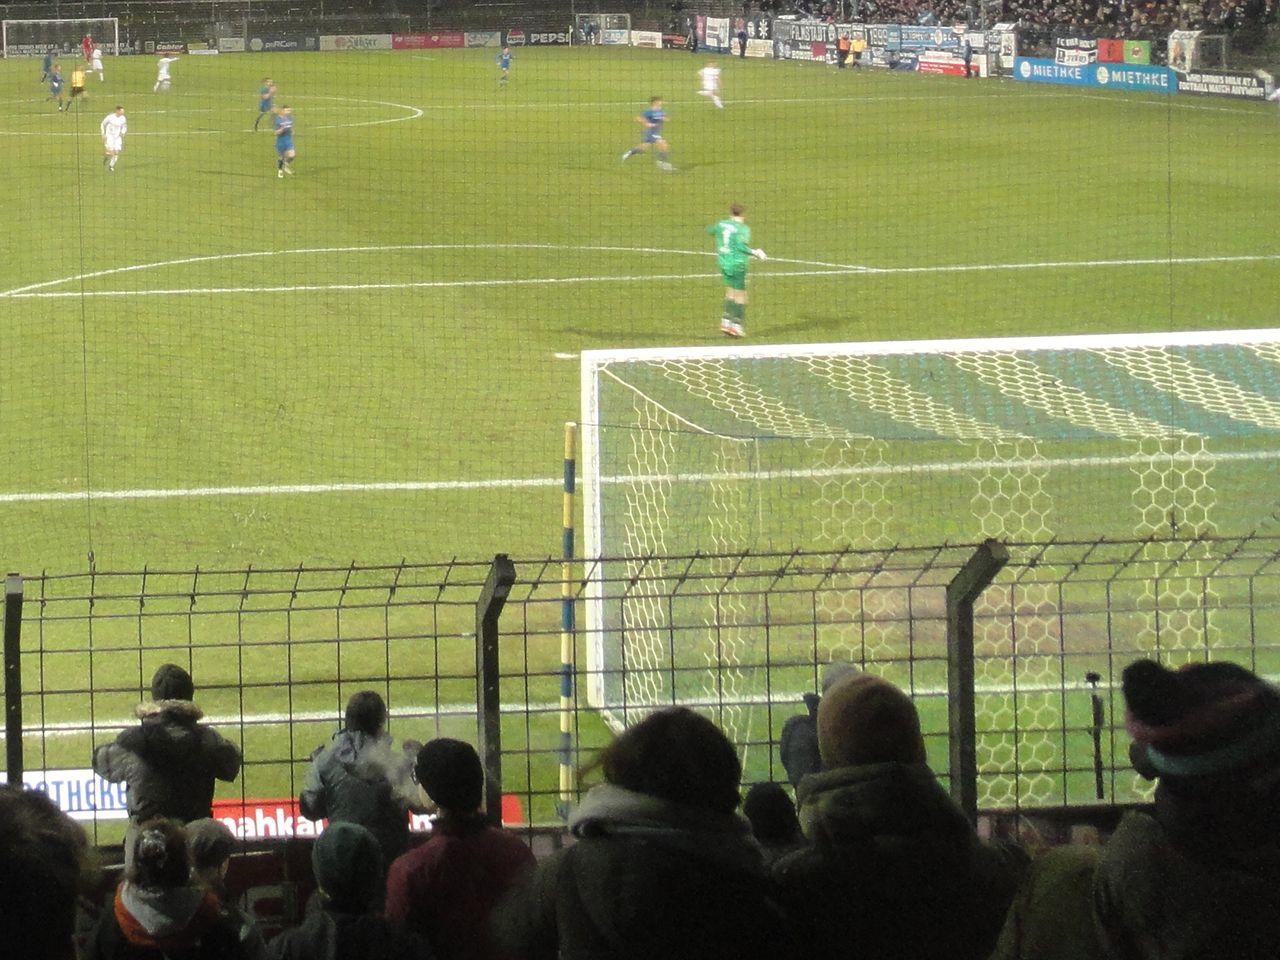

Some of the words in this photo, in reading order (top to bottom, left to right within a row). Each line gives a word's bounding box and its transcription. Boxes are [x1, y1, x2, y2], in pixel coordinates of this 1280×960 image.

[530, 32, 570, 43] PEPSI
[1033, 64, 1082, 80] MIETHKE
[1111, 70, 1169, 87] MIETHKE
[1178, 81, 1208, 92] FOOTBALL
[1208, 83, 1231, 94] MATCH
[217, 808, 326, 837] nahka
